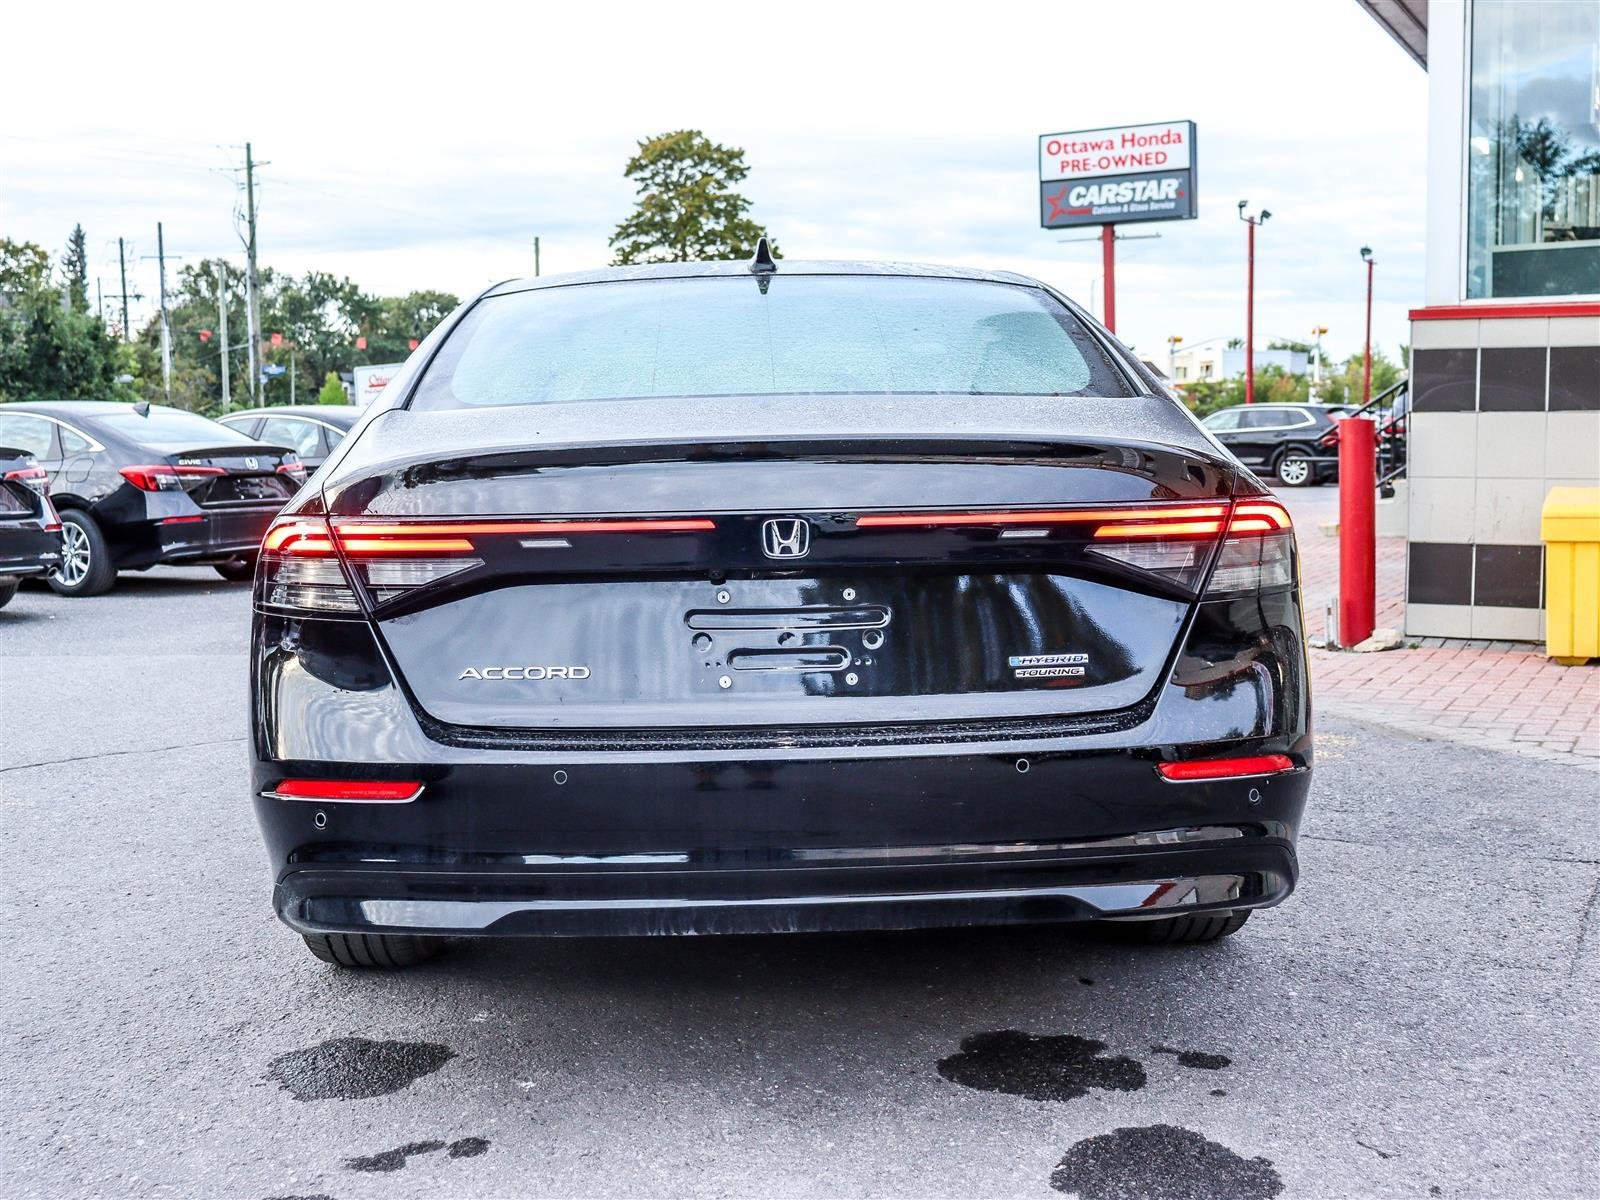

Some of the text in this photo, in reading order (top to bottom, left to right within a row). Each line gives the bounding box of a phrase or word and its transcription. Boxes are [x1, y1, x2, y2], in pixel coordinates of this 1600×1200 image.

[1047, 128, 1182, 156] Ottawa Honda
[1060, 151, 1168, 173] PRE-OWNED
[1068, 178, 1179, 207] CARSTAR
[458, 666, 592, 680] ACCORD
[1017, 668, 1080, 676] TOURING
